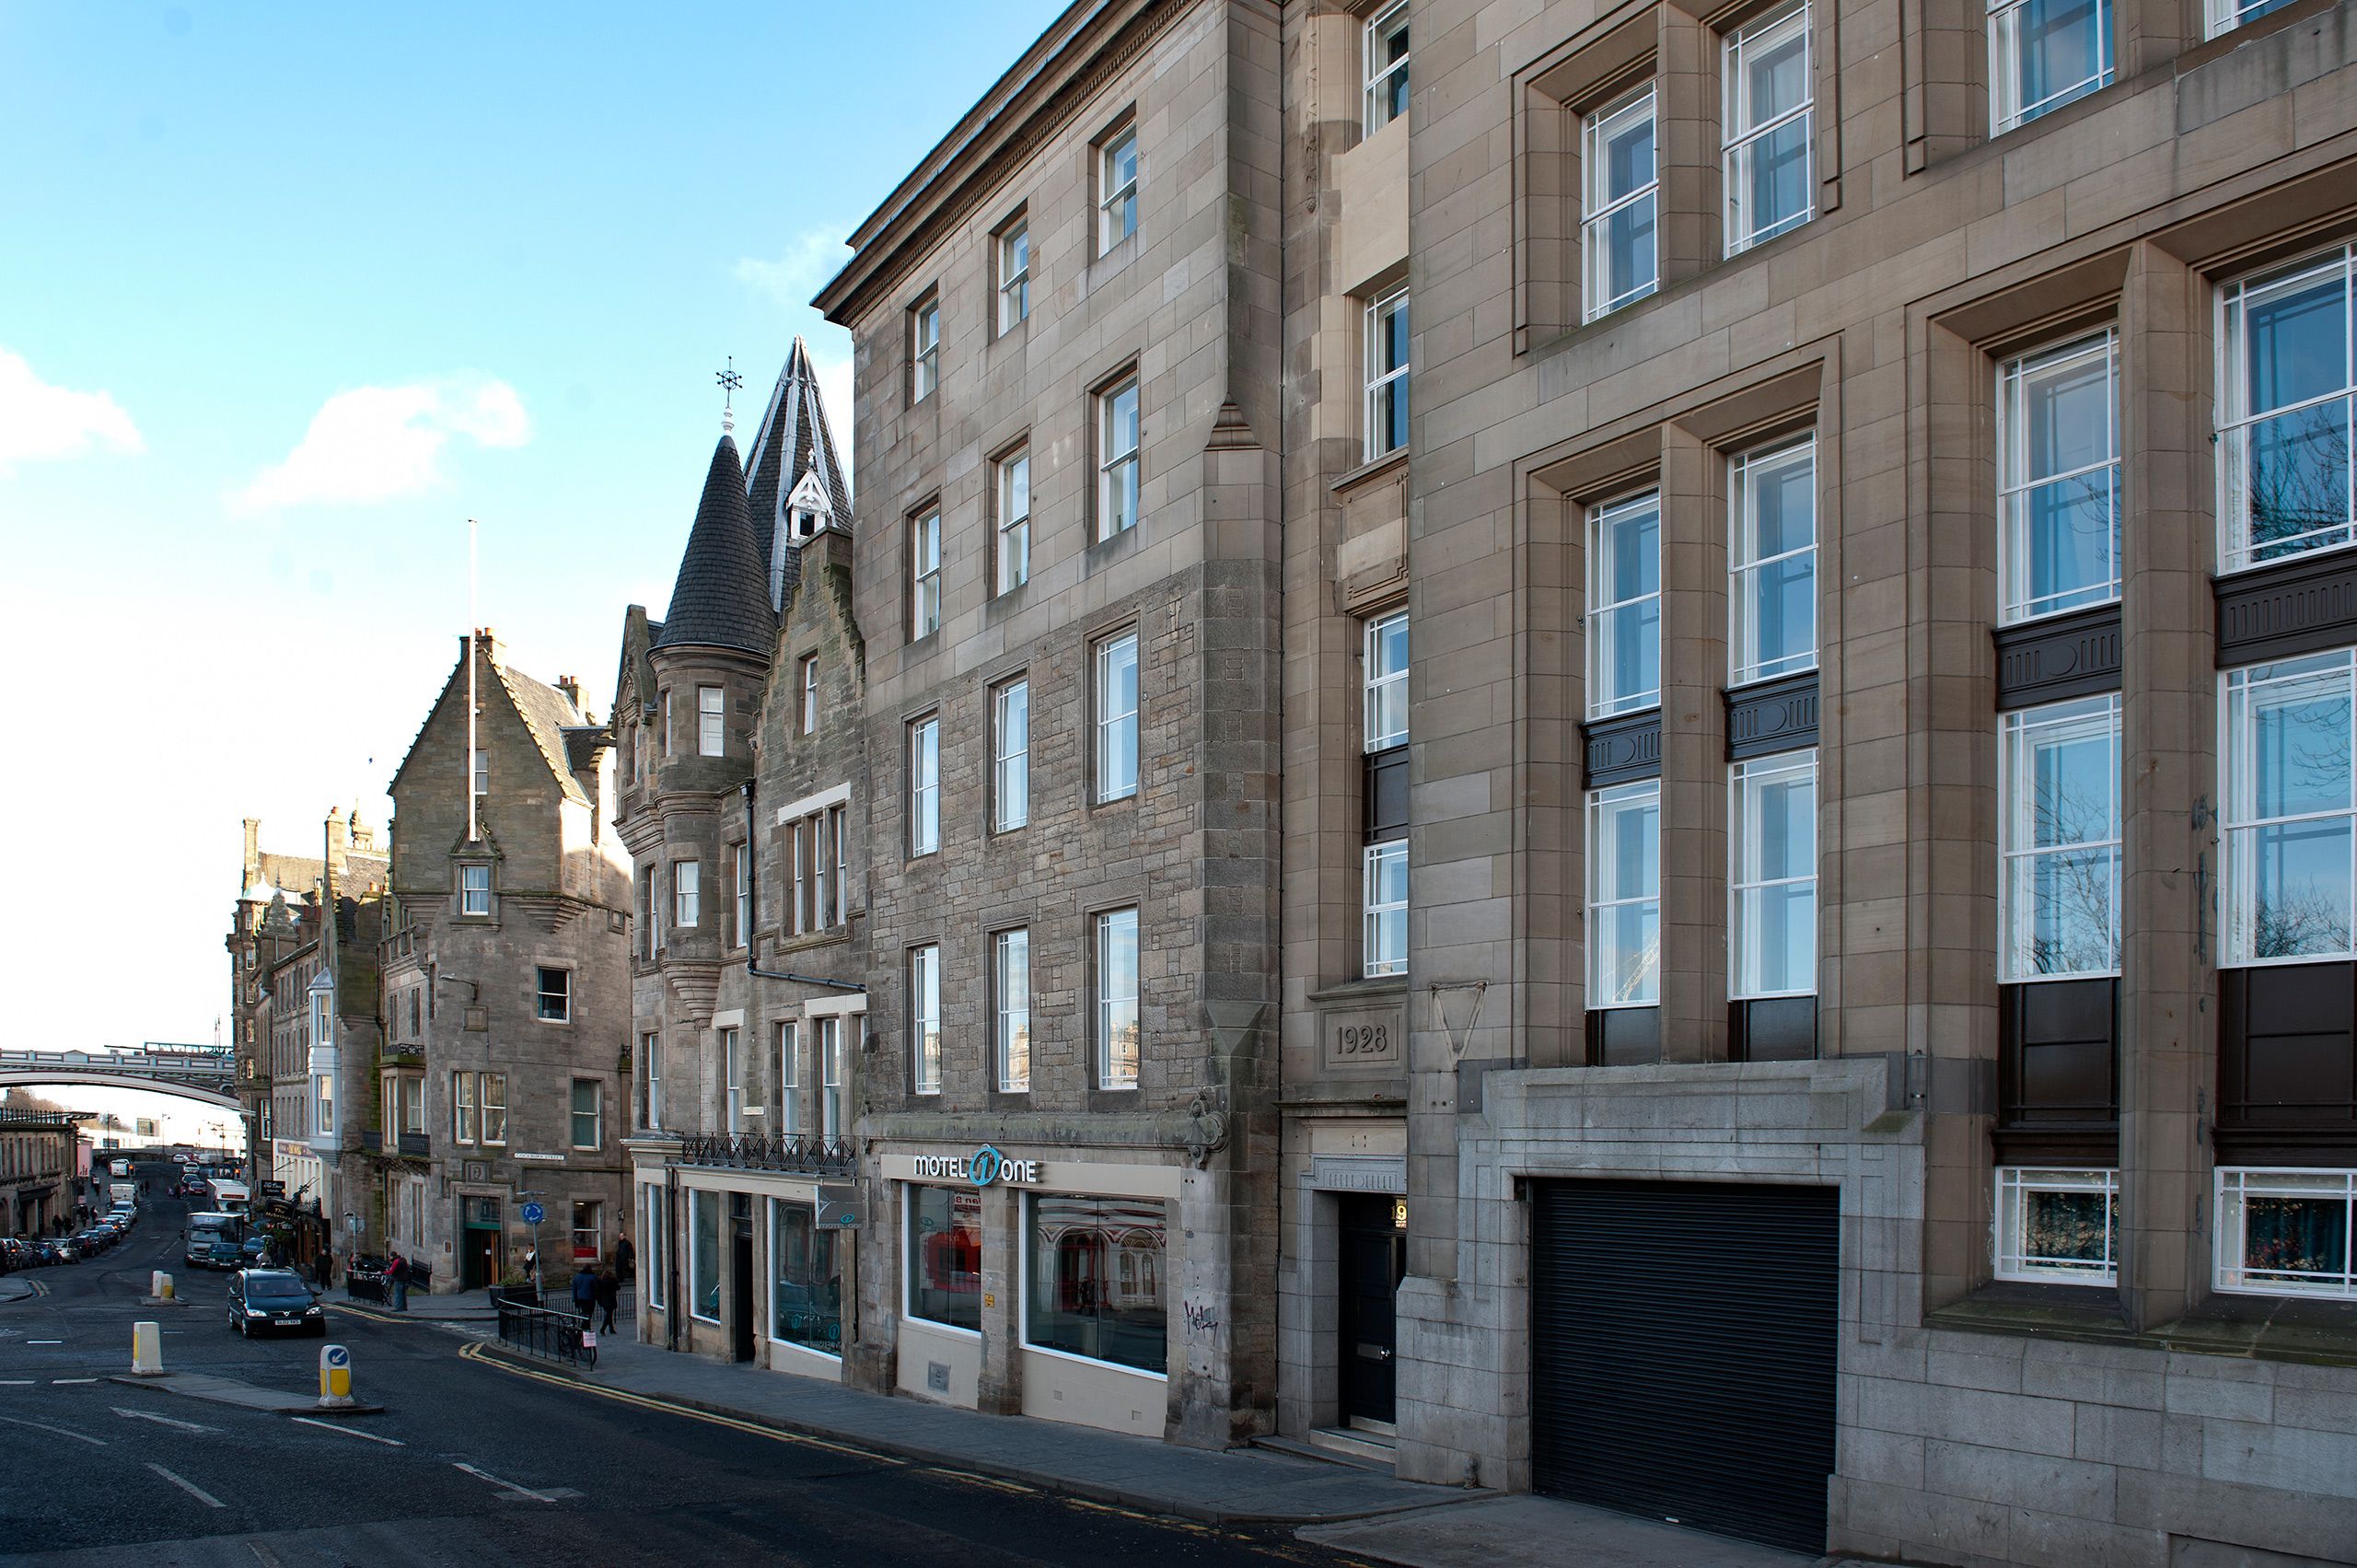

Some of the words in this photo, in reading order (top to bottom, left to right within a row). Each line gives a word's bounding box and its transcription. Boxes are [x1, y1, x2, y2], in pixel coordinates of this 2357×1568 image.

[1336, 1024, 1387, 1054] 1928
[914, 1156, 968, 1178] MOTEL
[1001, 1159, 1037, 1182] ONE
[1391, 1205, 1407, 1221] 19
